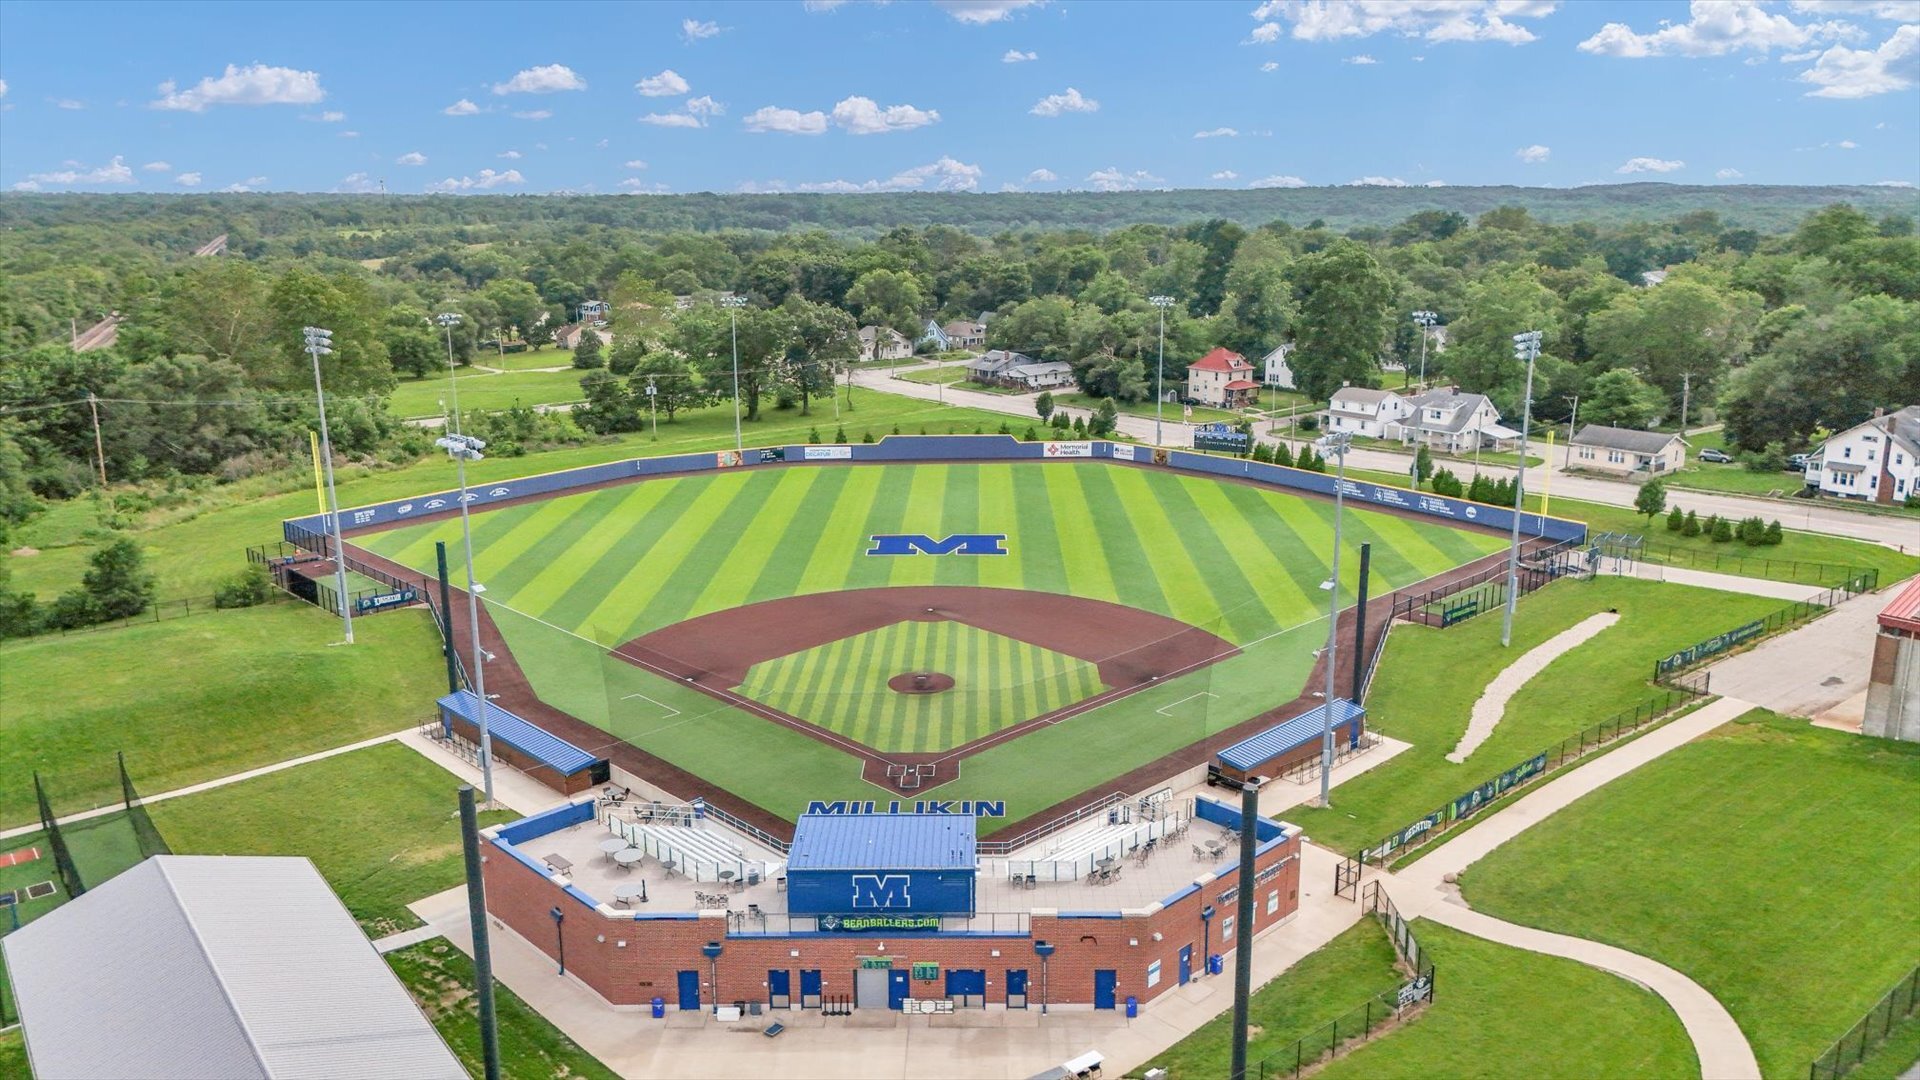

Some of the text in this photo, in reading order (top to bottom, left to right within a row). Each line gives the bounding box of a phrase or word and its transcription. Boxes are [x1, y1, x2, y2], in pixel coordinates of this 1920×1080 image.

[865, 534, 1009, 556] M
[806, 801, 1006, 818] MILLIKIN
[853, 875, 911, 908] M
